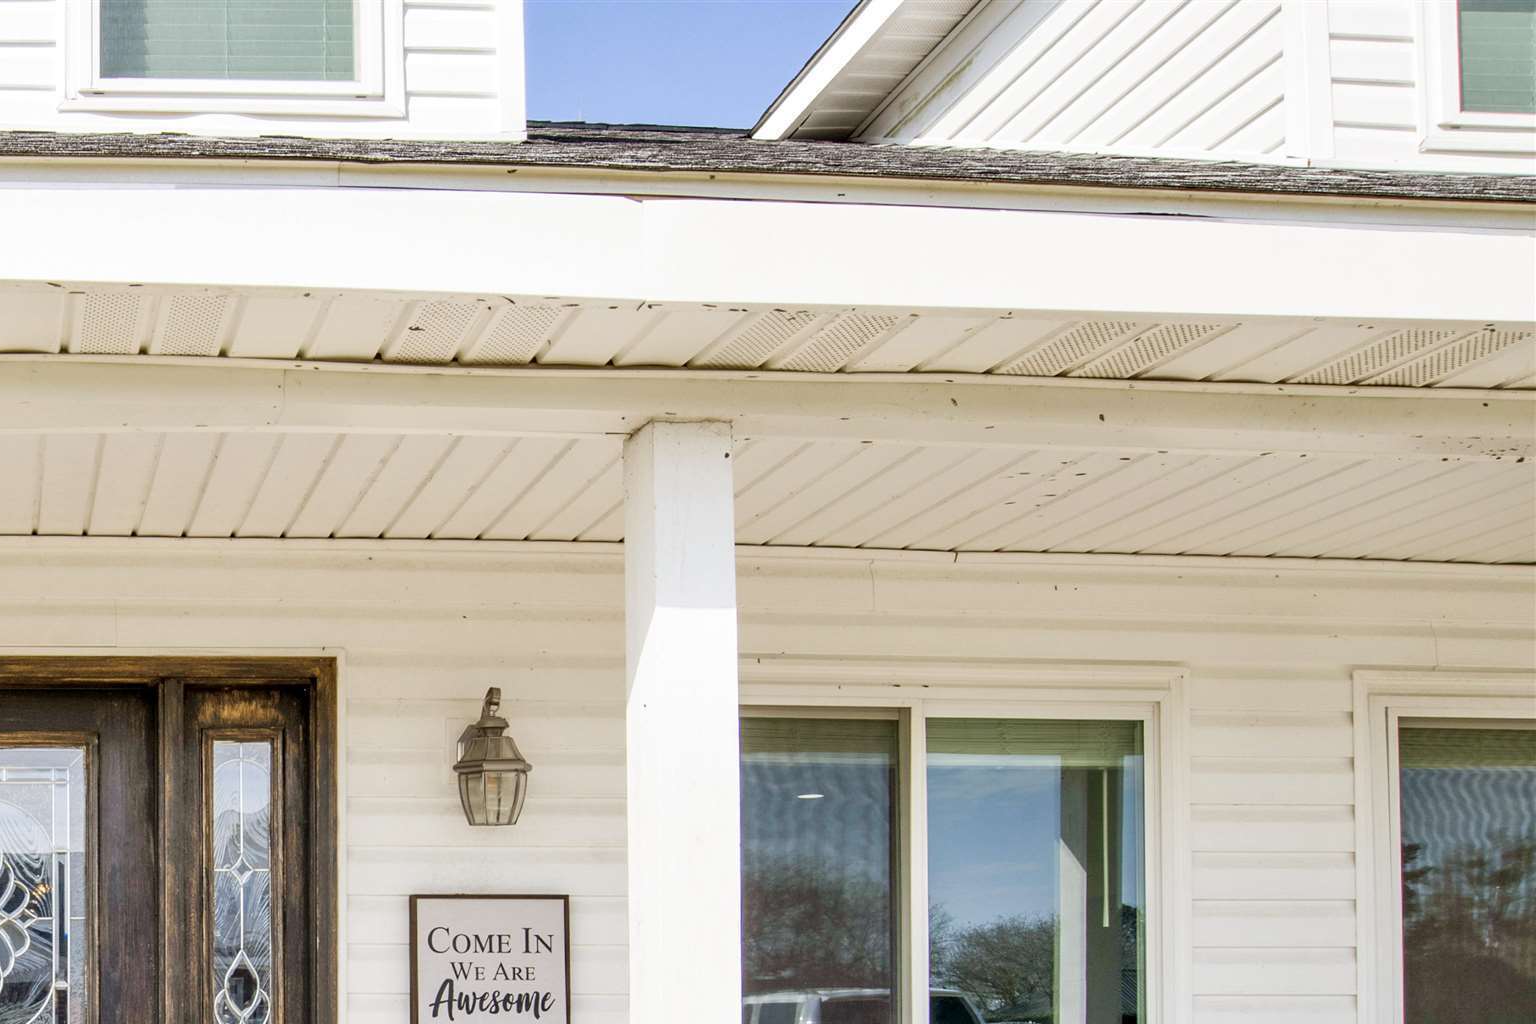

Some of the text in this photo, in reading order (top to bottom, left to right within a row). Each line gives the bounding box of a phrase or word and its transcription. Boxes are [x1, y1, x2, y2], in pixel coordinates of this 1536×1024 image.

[427, 926, 554, 953] COME IN
[450, 961, 536, 981] WE ARE
[428, 978, 556, 1021] Awesome
